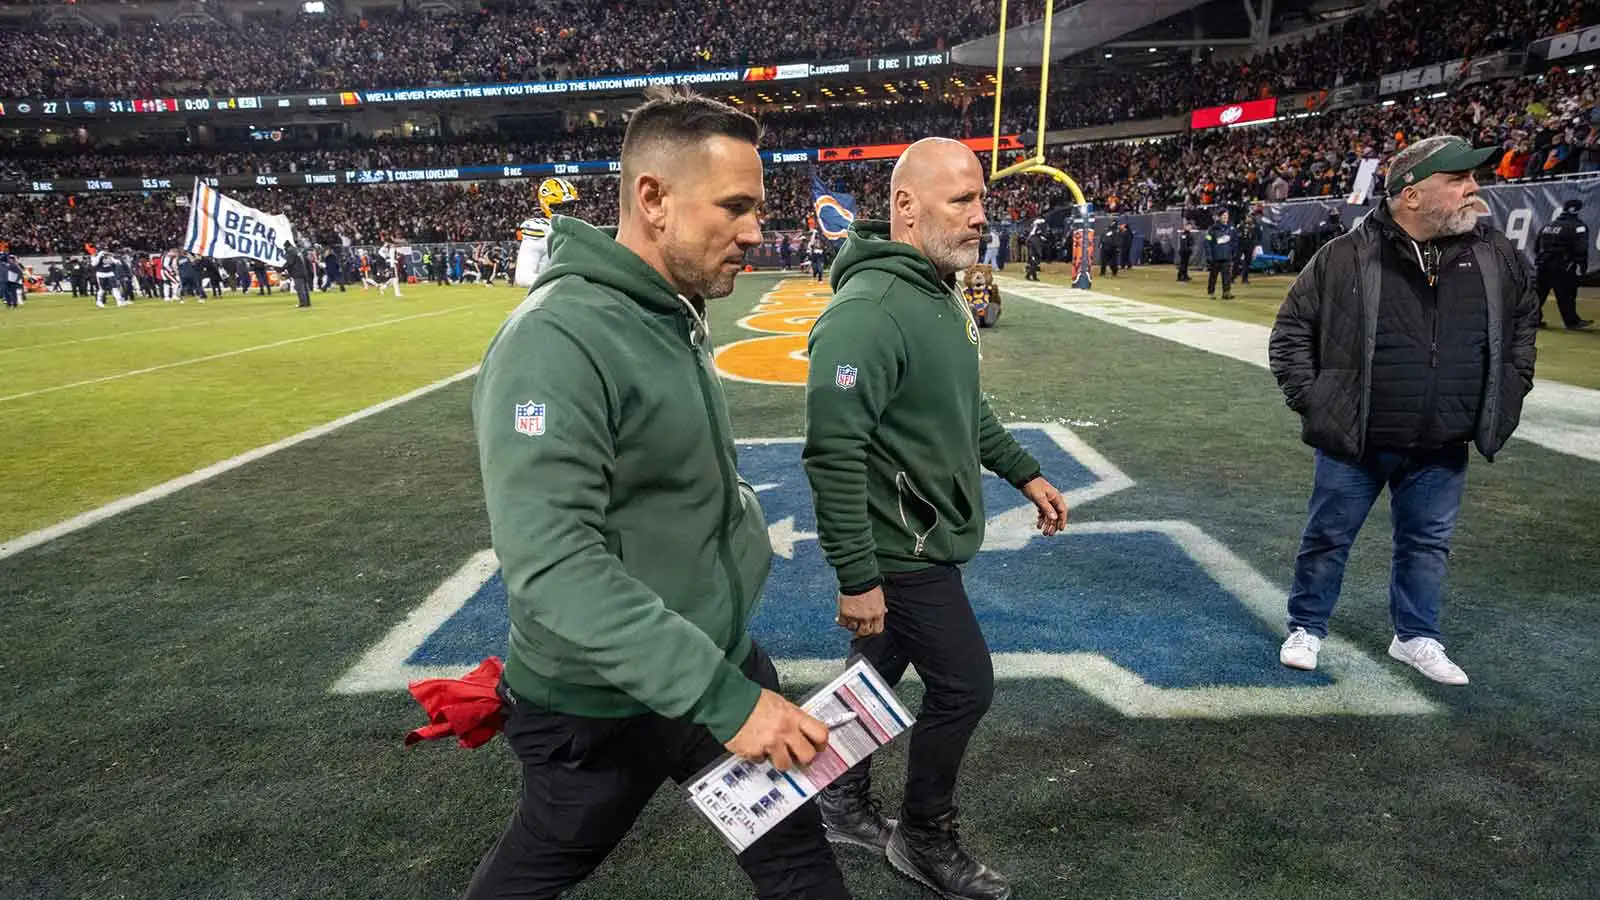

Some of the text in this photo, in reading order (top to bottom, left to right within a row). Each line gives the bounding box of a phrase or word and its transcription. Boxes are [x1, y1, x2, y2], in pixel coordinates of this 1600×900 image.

[878, 59, 885, 69] 8
[886, 59, 899, 68] REC
[914, 55, 927, 66] 137
[928, 54, 942, 65] YDS
[366, 72, 738, 102] WE'LL NEVER FORGET THE WAY YOU THRILLED THE NATION WITH YOUR T-FORMATION
[43, 102, 57, 113] 27
[109, 100, 123, 112] 31
[185, 98, 209, 110] 0:00
[228, 97, 236, 109] 4
[395, 170, 424, 180] COLSTON
[425, 169, 459, 179] LOVELAND
[503, 166, 509, 176] 8
[510, 167, 522, 176] REC
[773, 153, 782, 162] 15
[520, 416, 541, 432] NFL
